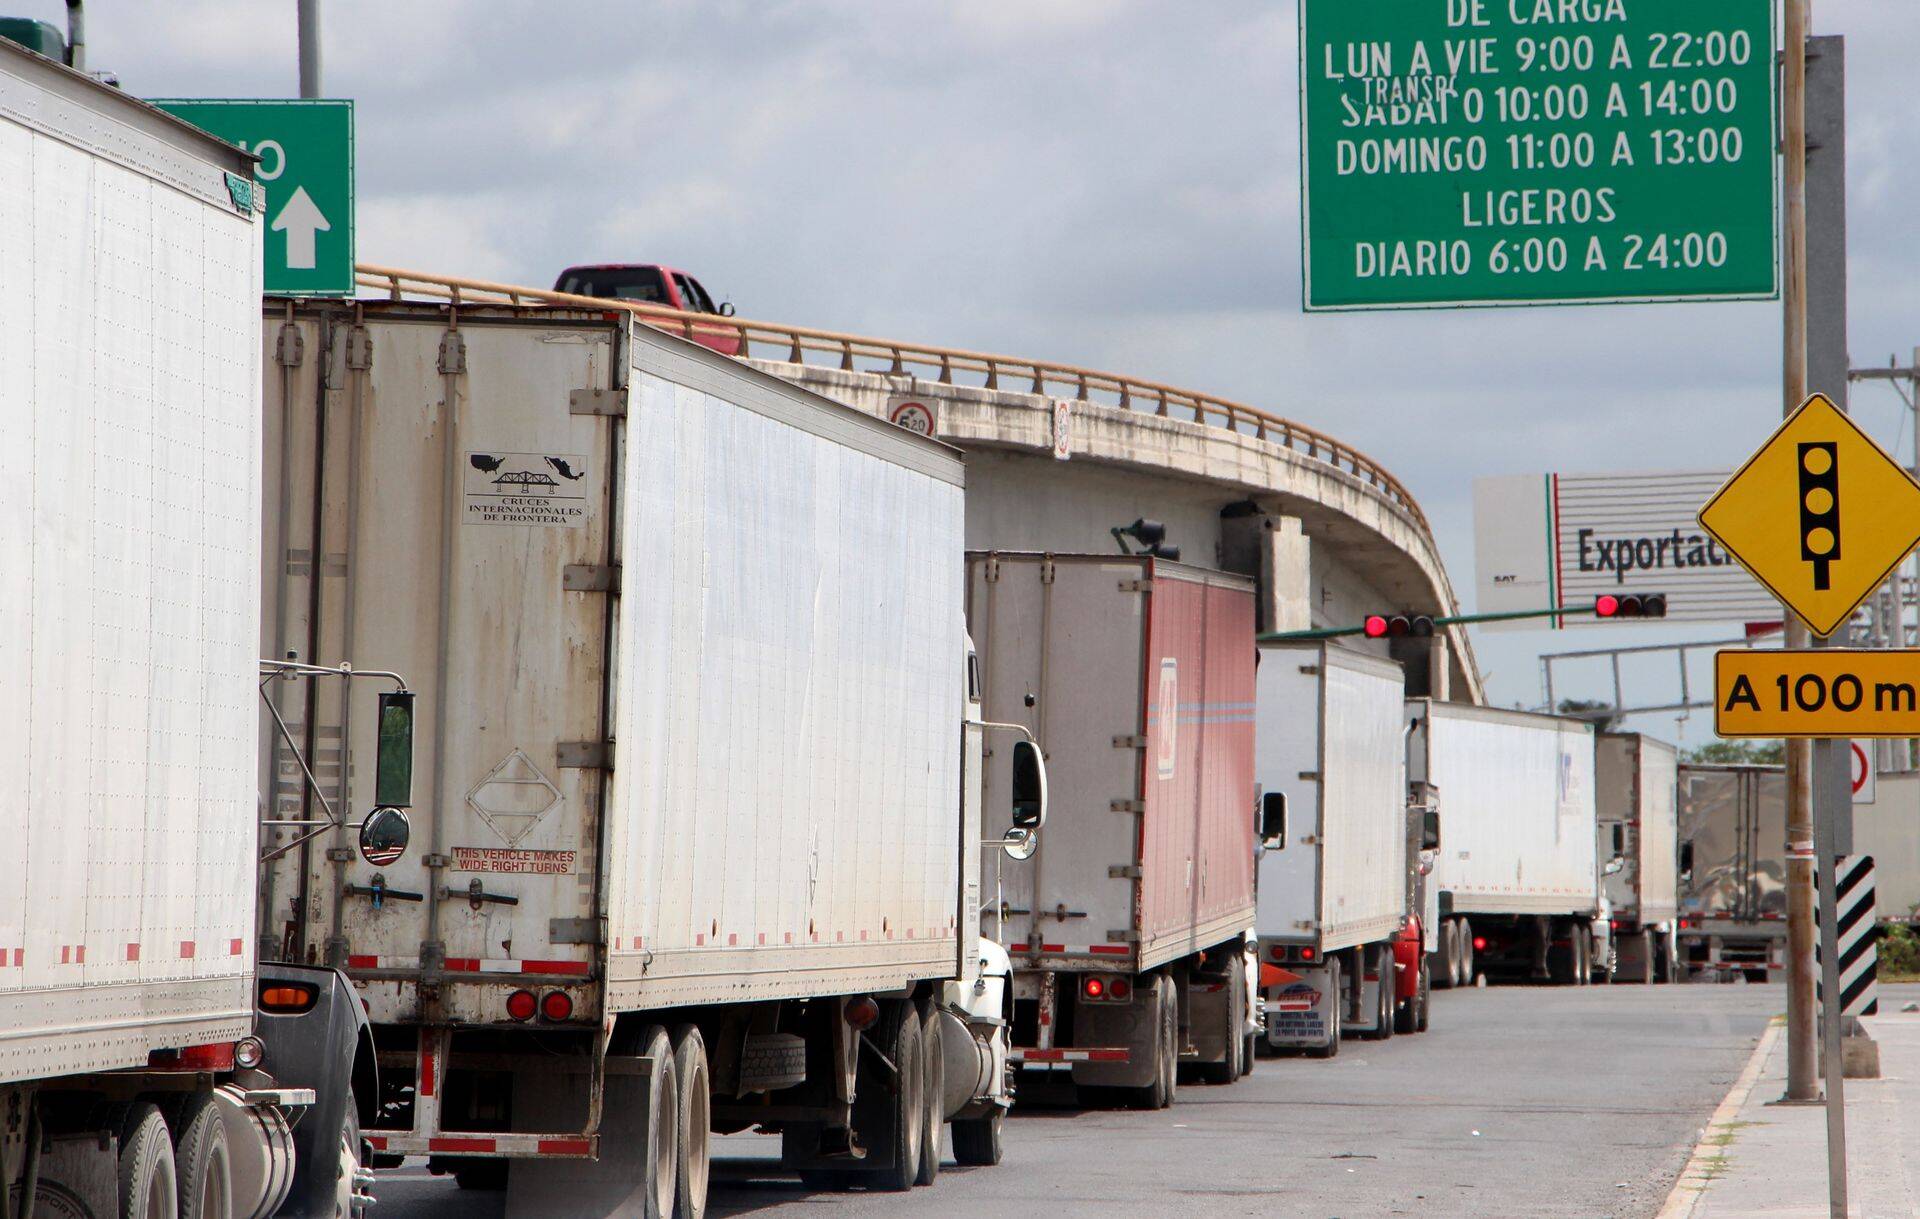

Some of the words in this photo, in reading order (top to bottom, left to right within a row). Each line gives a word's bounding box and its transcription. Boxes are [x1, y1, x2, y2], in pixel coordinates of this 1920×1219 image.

[1446, 0, 1492, 28] DE
[1510, 0, 1627, 25] CARGA
[1325, 42, 1392, 79] LUN
[1410, 40, 1432, 76] A
[1446, 38, 1499, 75] VIE
[1516, 36, 1594, 73] 9:00
[1609, 34, 1632, 70] A
[1648, 30, 1751, 68] 22:00
[1495, 86, 1591, 122] 10:00
[1605, 83, 1628, 118] A
[1640, 78, 1737, 116] 14:00
[1337, 135, 1487, 175] DOMINGO
[1506, 132, 1595, 170] 11:00
[1611, 130, 1634, 166] A
[1650, 126, 1743, 165] 13:00
[1463, 187, 1616, 227] LIGEROS
[1355, 240, 1471, 277] DIARIO
[1488, 237, 1568, 273] 6:00
[1584, 235, 1606, 271] A
[1623, 232, 1727, 270] 24:00
[469, 505, 582, 516] INTERNACIONALES
[502, 498, 550, 506] CRUCES
[502, 515, 567, 524] FRONTERA
[1724, 674, 1761, 712] A
[1776, 674, 1863, 712] 100
[1874, 685, 1916, 712] m
[455, 849, 479, 859] THIS
[483, 849, 530, 861] VEHICLE
[533, 851, 574, 863] MAKES
[460, 860, 489, 870] WIDE
[492, 861, 527, 872] RIGHT
[530, 863, 568, 873] TURNS
